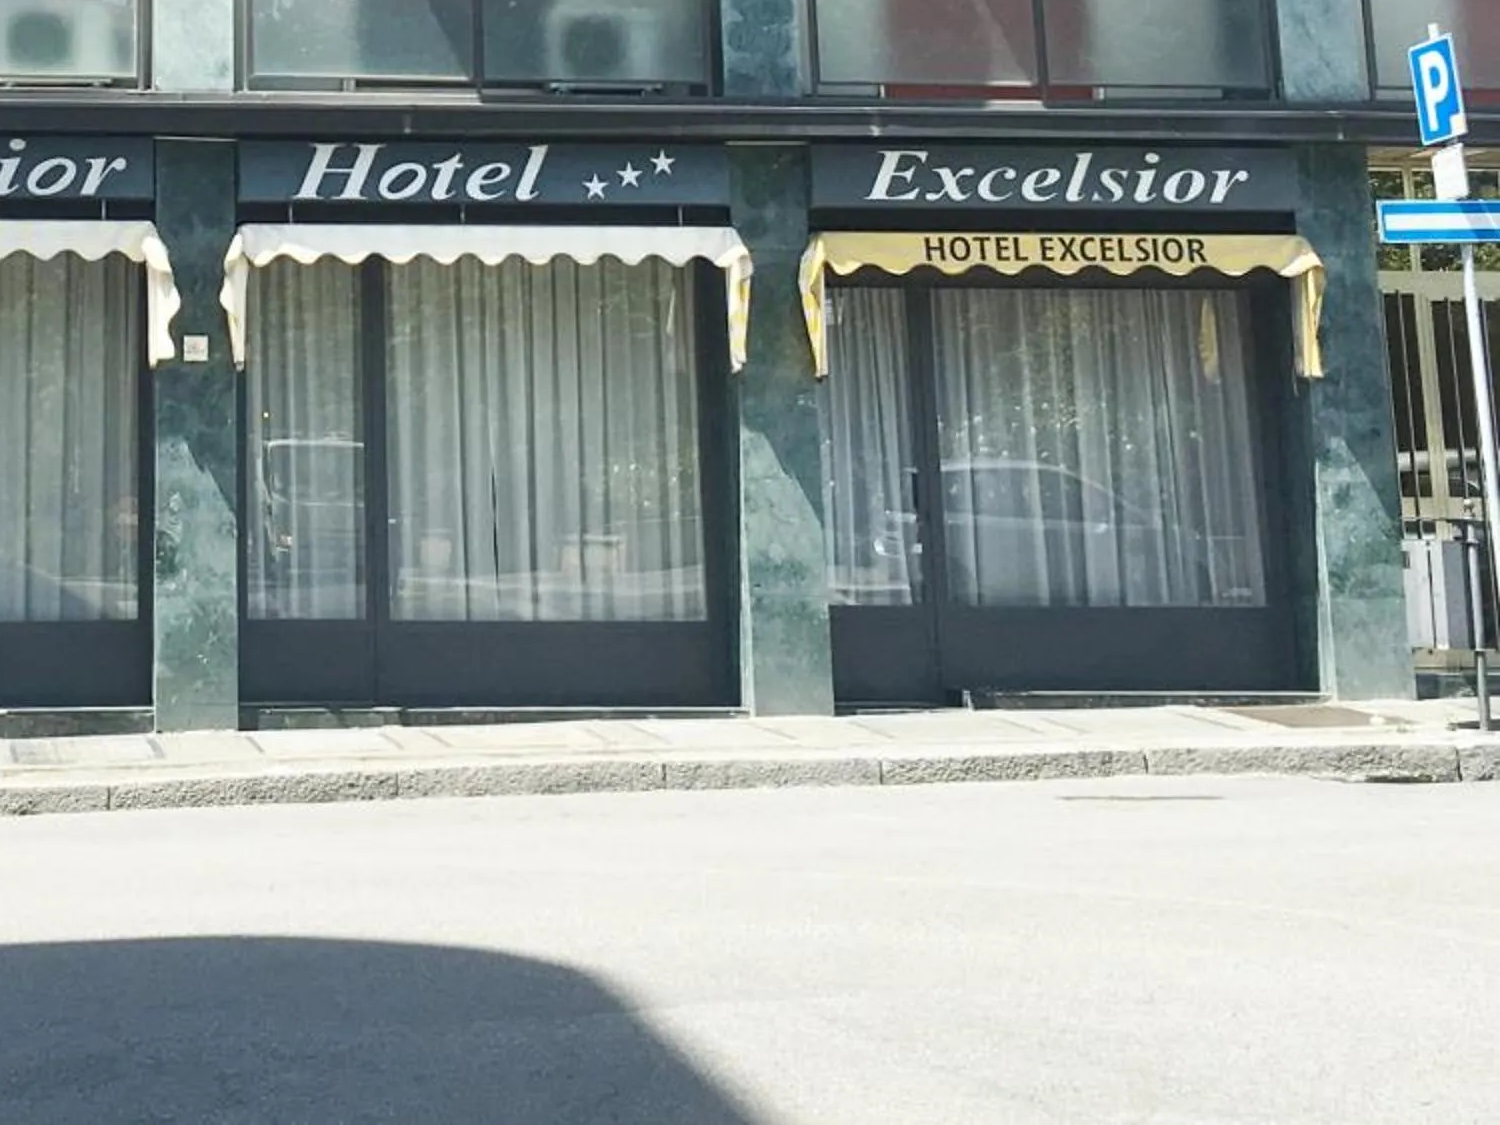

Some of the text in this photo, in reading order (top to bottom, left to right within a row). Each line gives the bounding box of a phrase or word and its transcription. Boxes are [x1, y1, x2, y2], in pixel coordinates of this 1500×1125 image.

[1418, 50, 1449, 132] P
[294, 142, 1250, 204] Hotel Excelsior
[923, 235, 1207, 264] HOTEL EXCELSIOR
